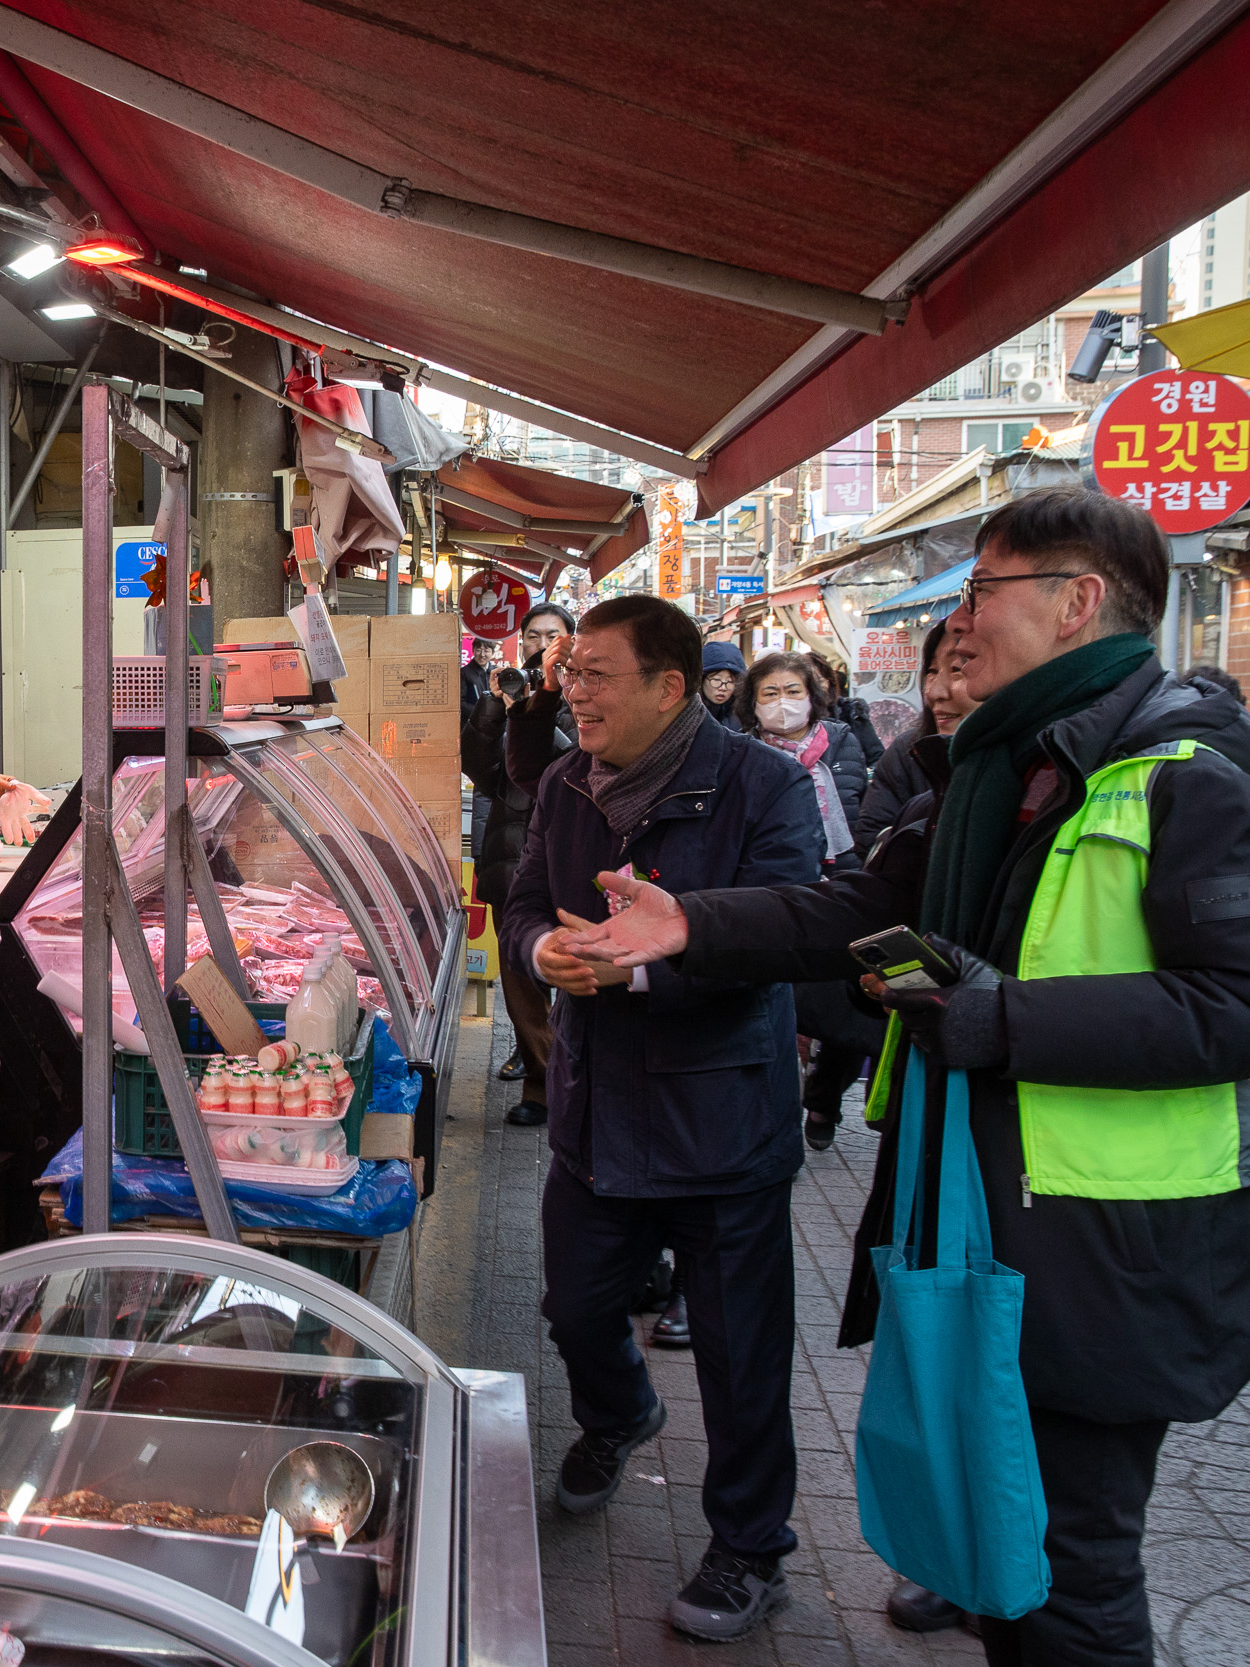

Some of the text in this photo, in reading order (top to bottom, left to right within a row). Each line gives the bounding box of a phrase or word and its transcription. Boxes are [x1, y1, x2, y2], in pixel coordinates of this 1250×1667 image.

[1151, 380, 1217, 414] 경원
[1102, 420, 1250, 473] 고깃집
[1120, 480, 1232, 511] 삼겹살
[137, 546, 167, 560] CESC
[866, 630, 910, 645] 오늘은
[858, 645, 917, 660] 육사시미
[858, 660, 918, 671] 들어오는날
